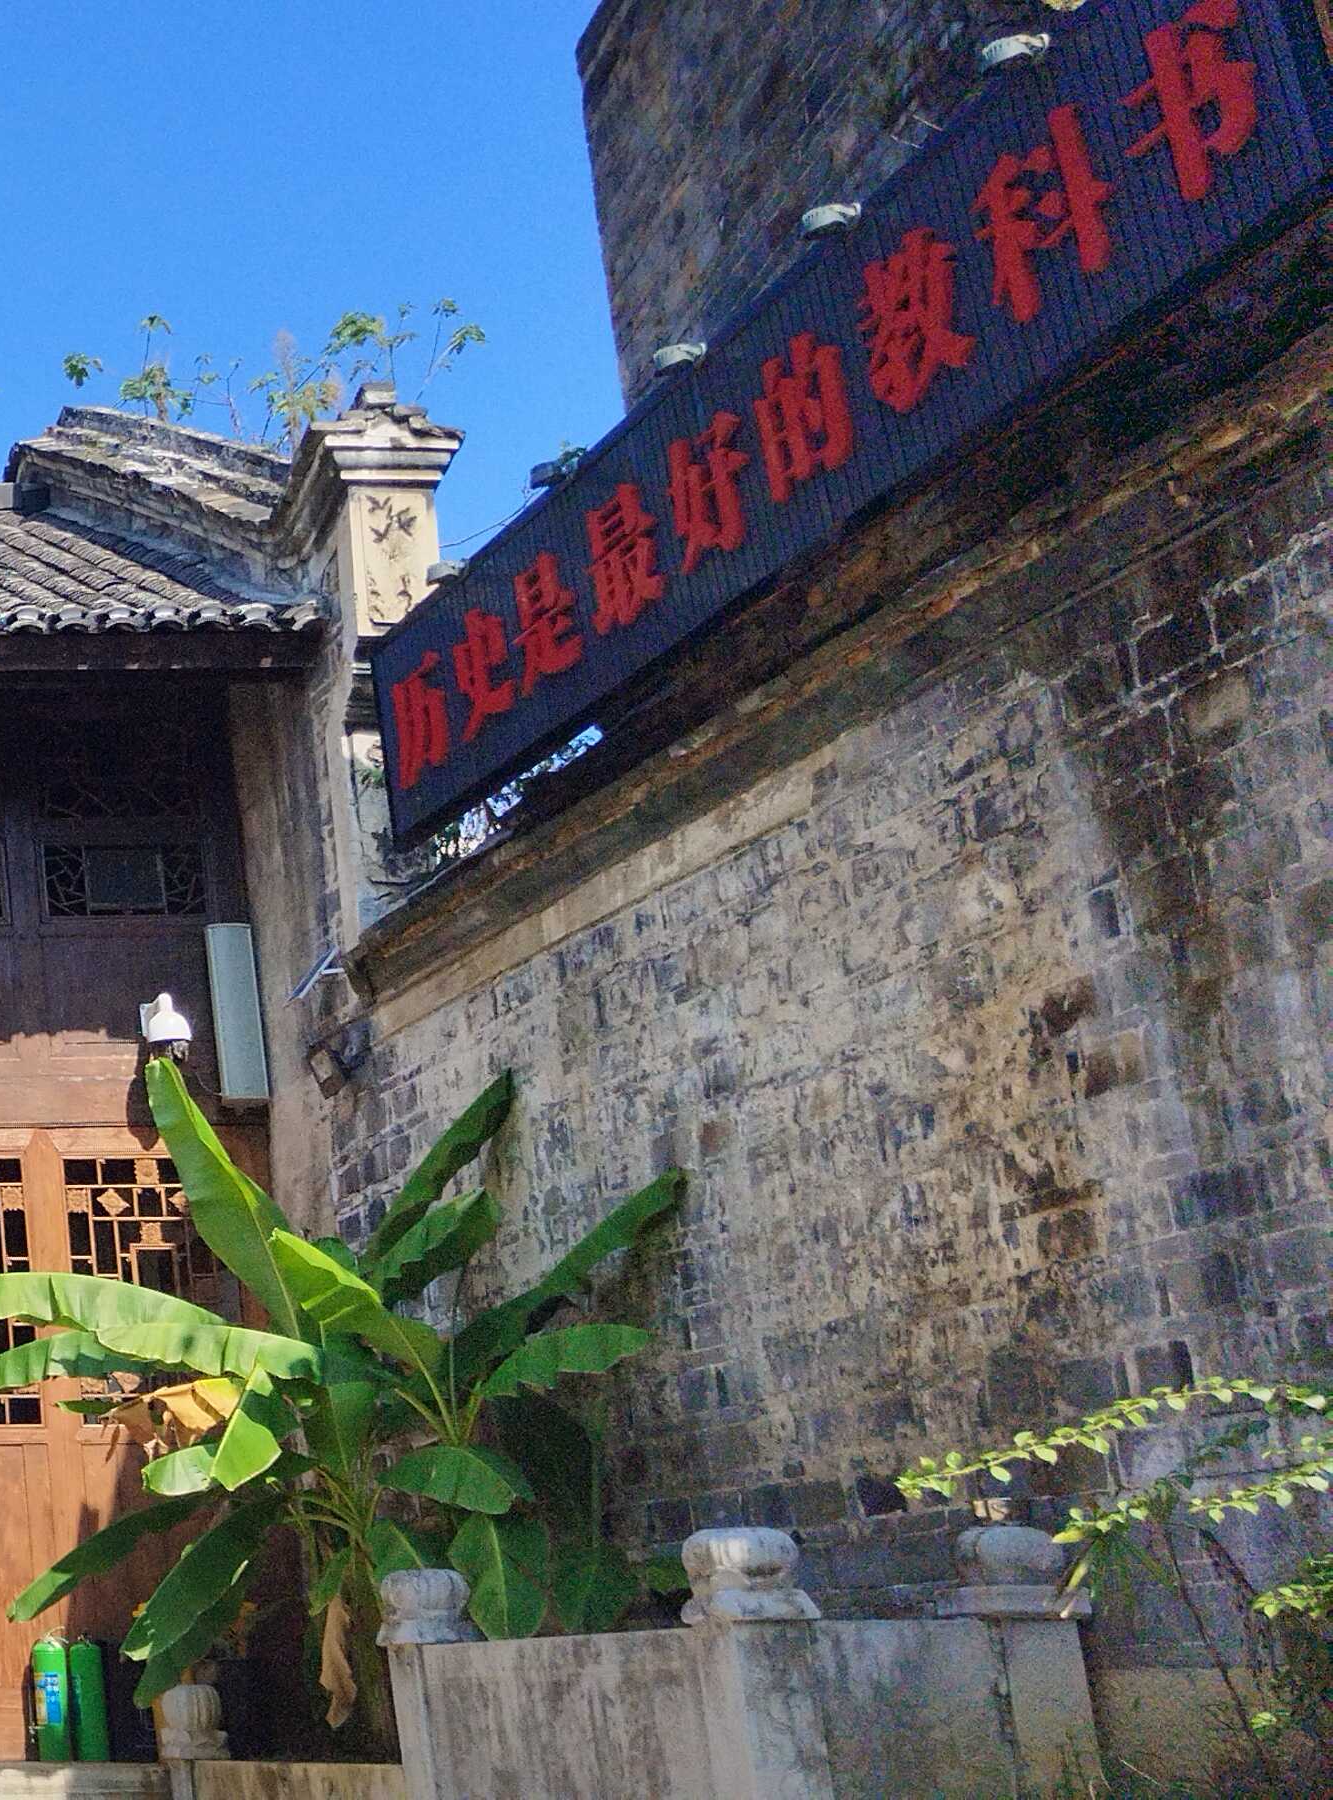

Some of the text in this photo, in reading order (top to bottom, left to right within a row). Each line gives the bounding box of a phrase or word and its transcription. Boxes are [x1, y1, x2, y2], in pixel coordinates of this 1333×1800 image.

[391, 0, 1257, 789] 历史是最好的教科书
